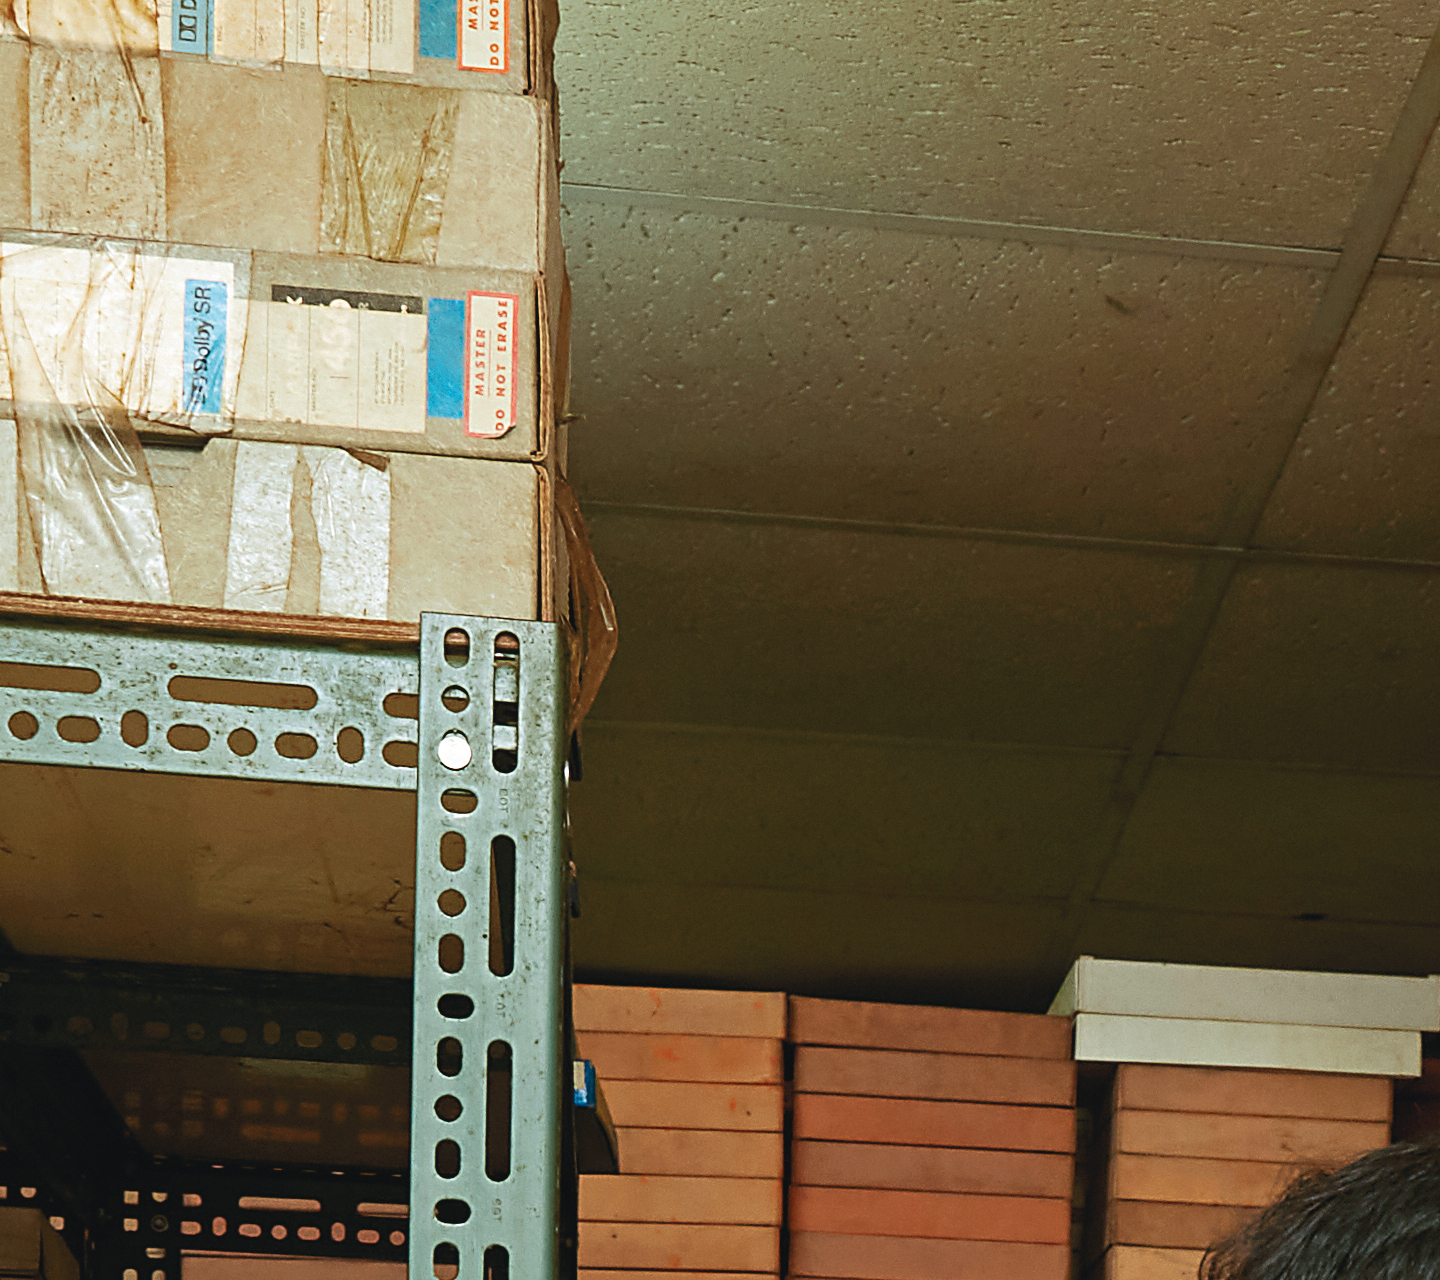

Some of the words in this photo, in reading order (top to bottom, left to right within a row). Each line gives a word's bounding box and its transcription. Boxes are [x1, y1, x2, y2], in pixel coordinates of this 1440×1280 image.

[195, 285, 211, 318] SR
[497, 300, 508, 353] ERASE
[476, 329, 485, 396] MASTER
[496, 357, 506, 397] NOT
[496, 409, 505, 431] DO
